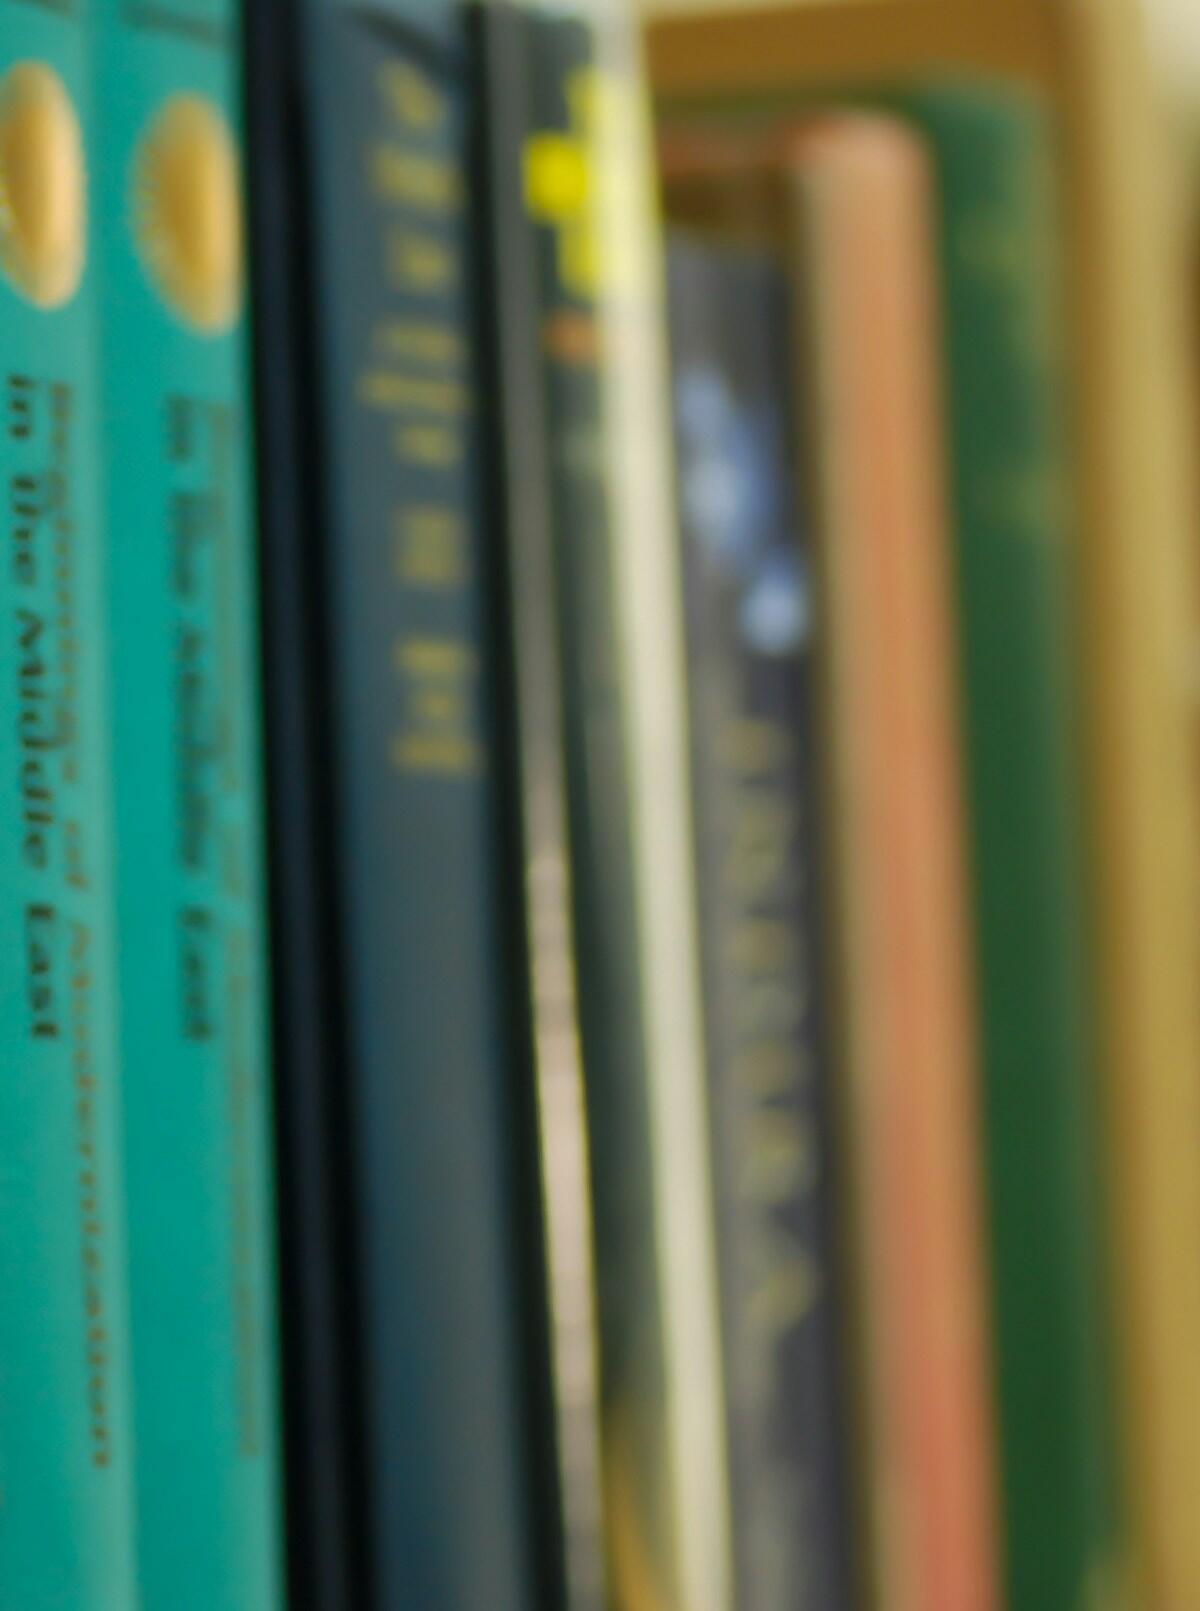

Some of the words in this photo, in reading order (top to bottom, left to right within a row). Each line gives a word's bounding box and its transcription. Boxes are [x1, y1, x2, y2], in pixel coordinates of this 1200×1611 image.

[11, 475, 41, 586] the
[15, 610, 55, 868] Middle
[26, 904, 58, 1040] East
